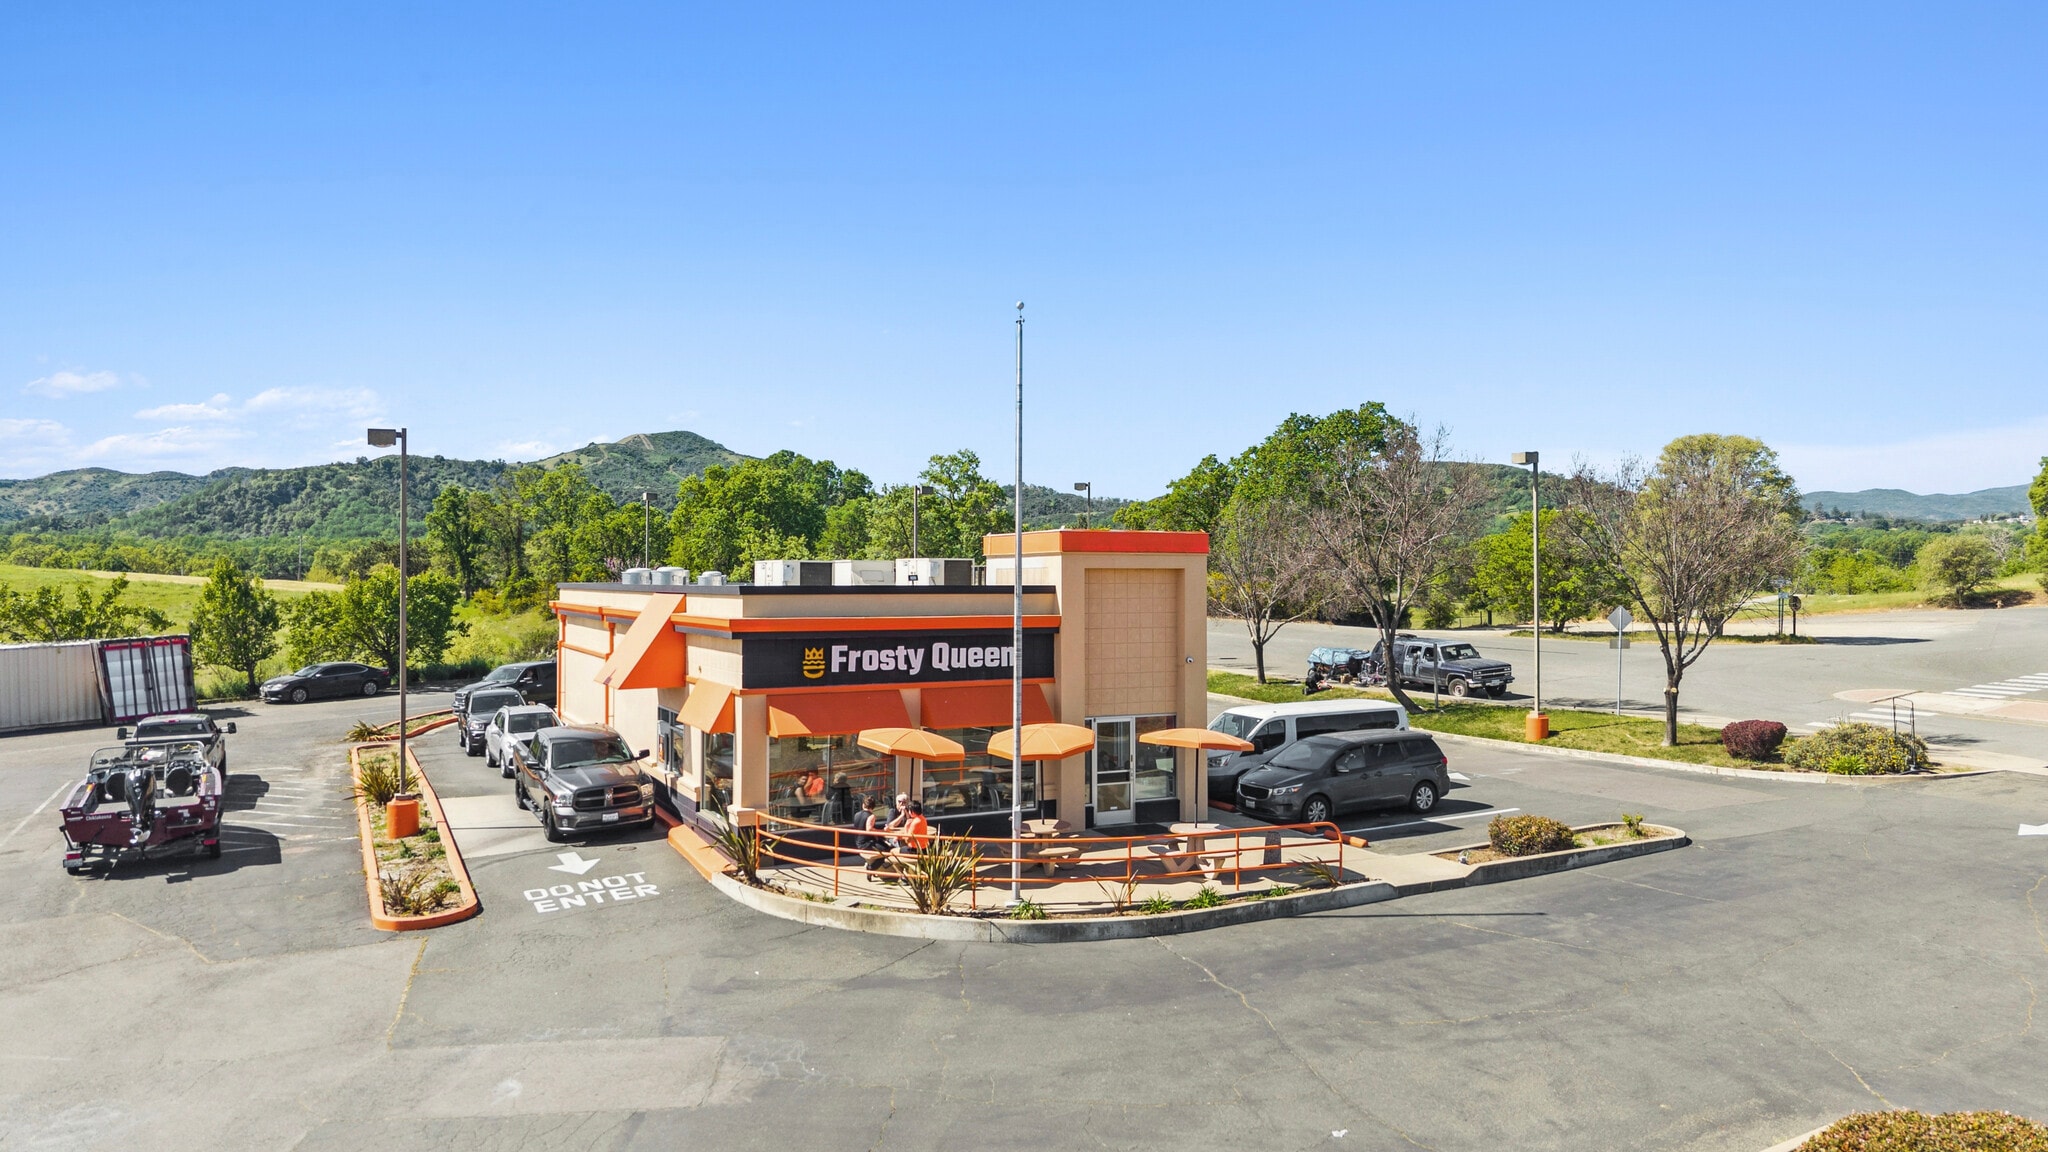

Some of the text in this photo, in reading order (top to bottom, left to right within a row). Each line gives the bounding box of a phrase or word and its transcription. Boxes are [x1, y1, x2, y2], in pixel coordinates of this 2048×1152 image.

[831, 641, 1015, 676] Frosty Queen
[523, 871, 646, 902] DO NOT
[533, 883, 661, 914] ENTER
